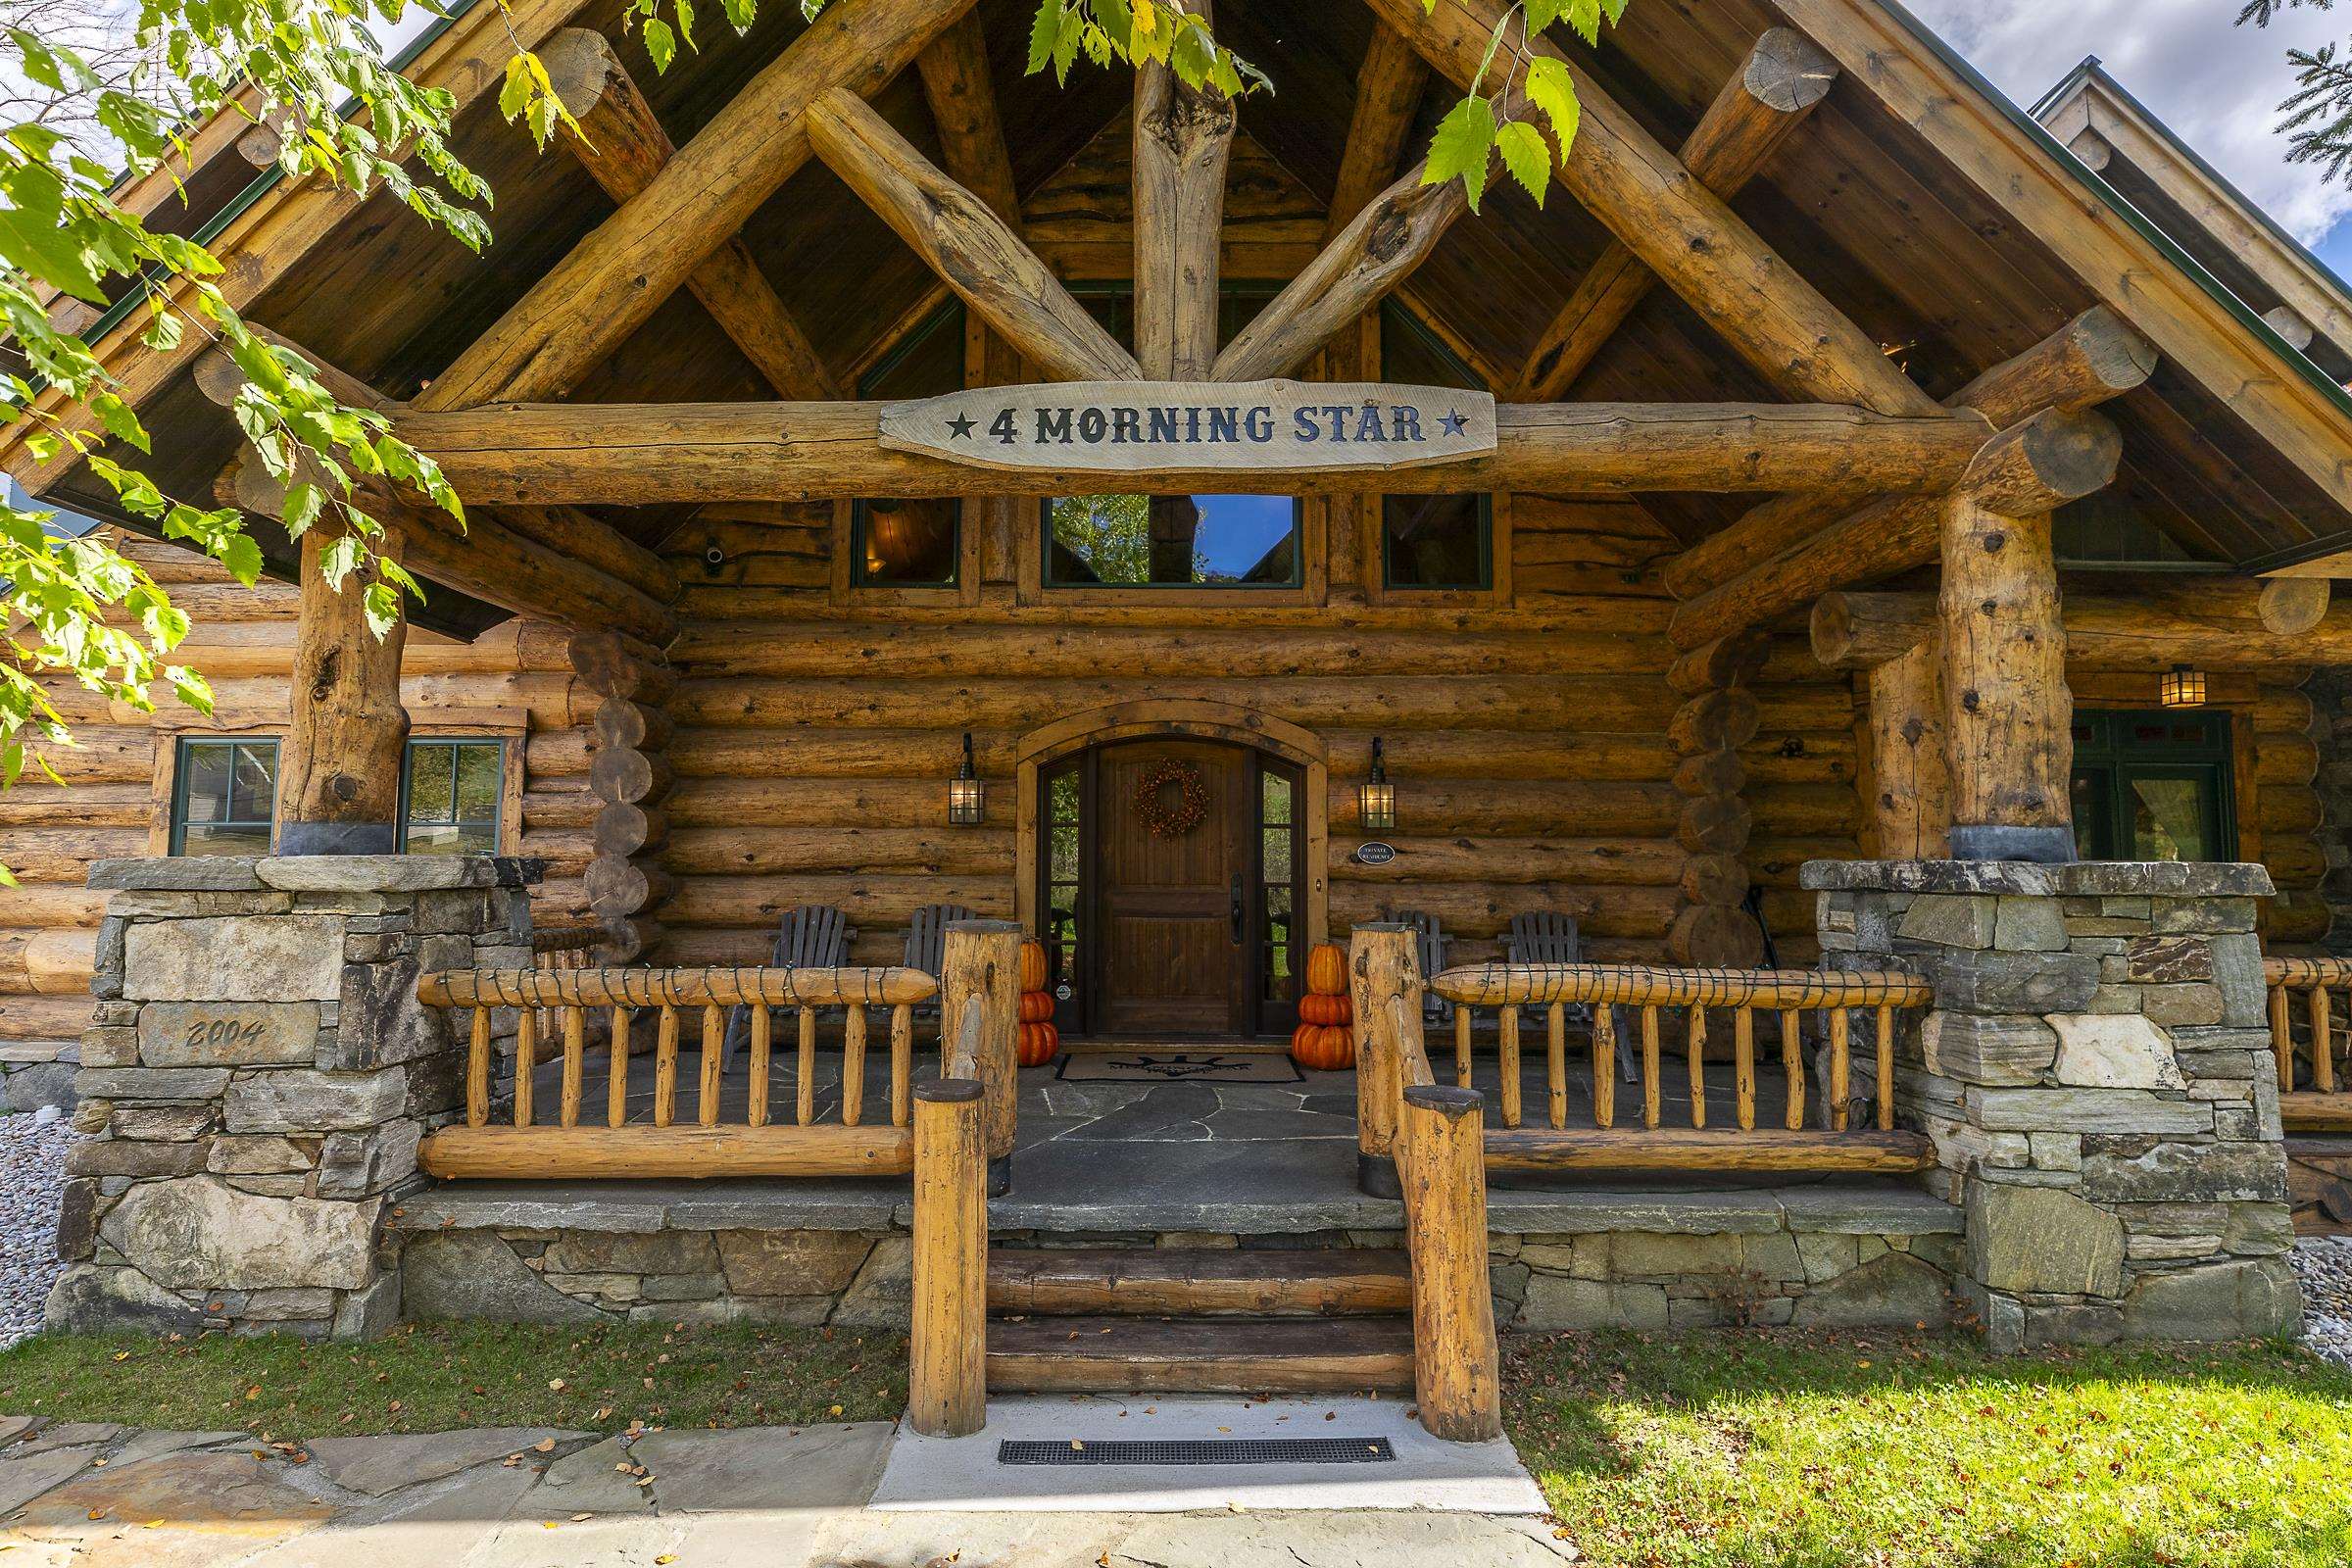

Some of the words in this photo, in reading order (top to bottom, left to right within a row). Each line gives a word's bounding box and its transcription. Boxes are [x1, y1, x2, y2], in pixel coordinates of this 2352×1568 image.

[989, 408, 1018, 444] 4
[1294, 406, 1427, 442] STAR
[186, 1020, 267, 1047] 2004
